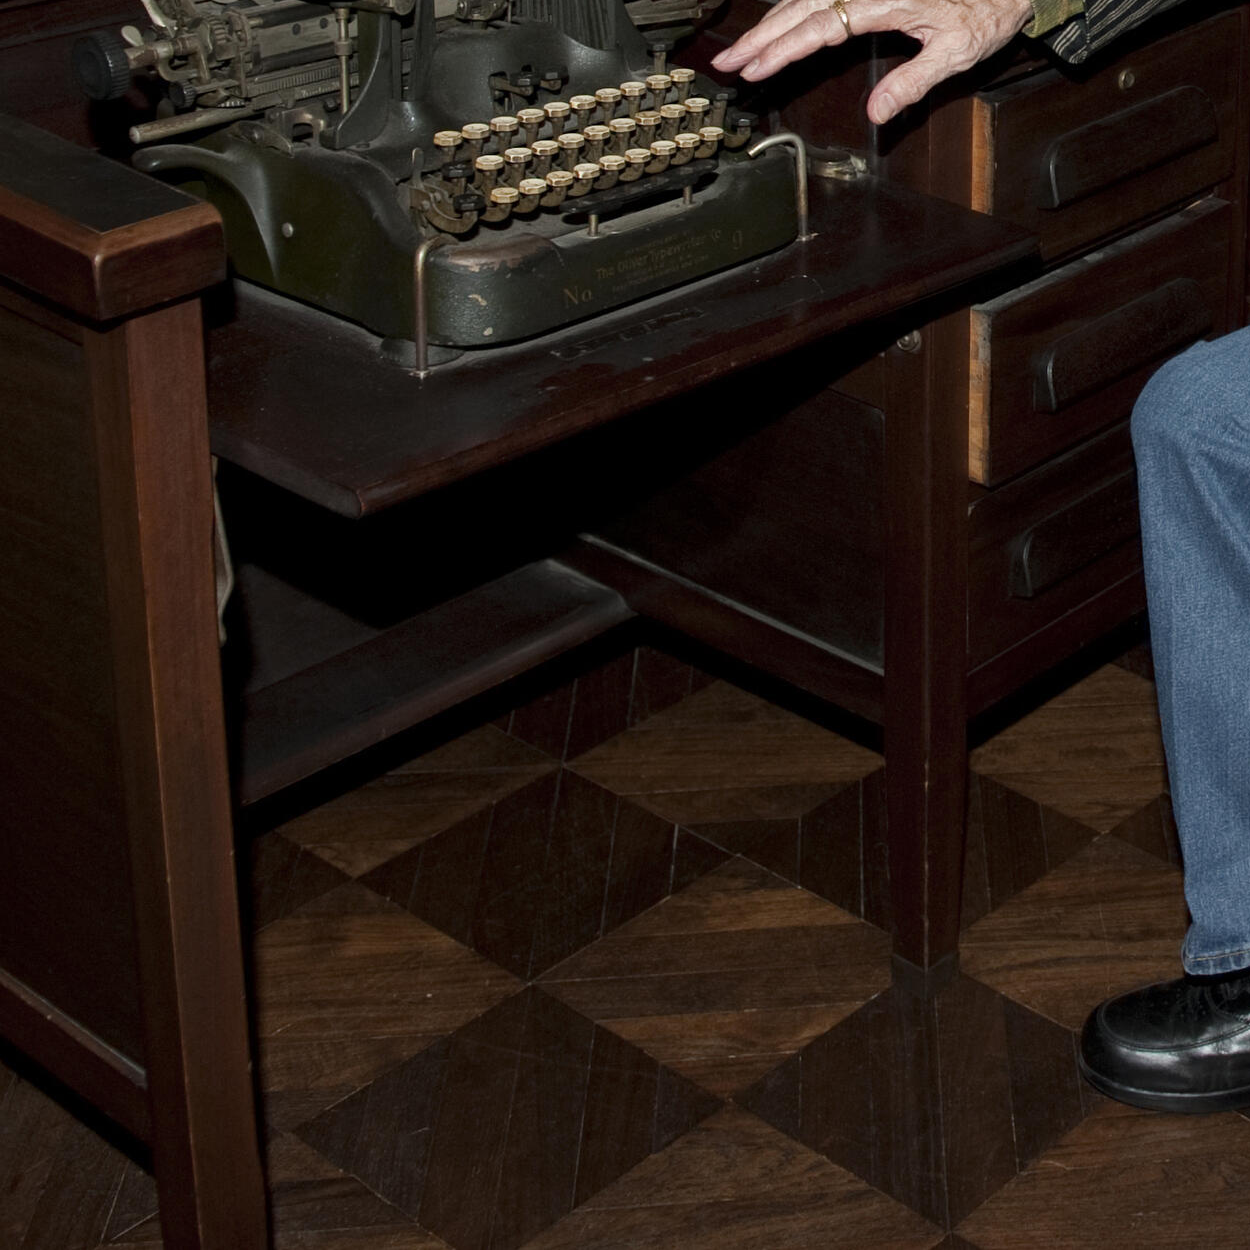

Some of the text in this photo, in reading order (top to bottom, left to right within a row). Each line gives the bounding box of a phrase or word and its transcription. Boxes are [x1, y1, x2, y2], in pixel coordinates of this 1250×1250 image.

[596, 267, 615, 279] The
[617, 254, 648, 270] Oliver
[649, 235, 707, 259] Typewriter
